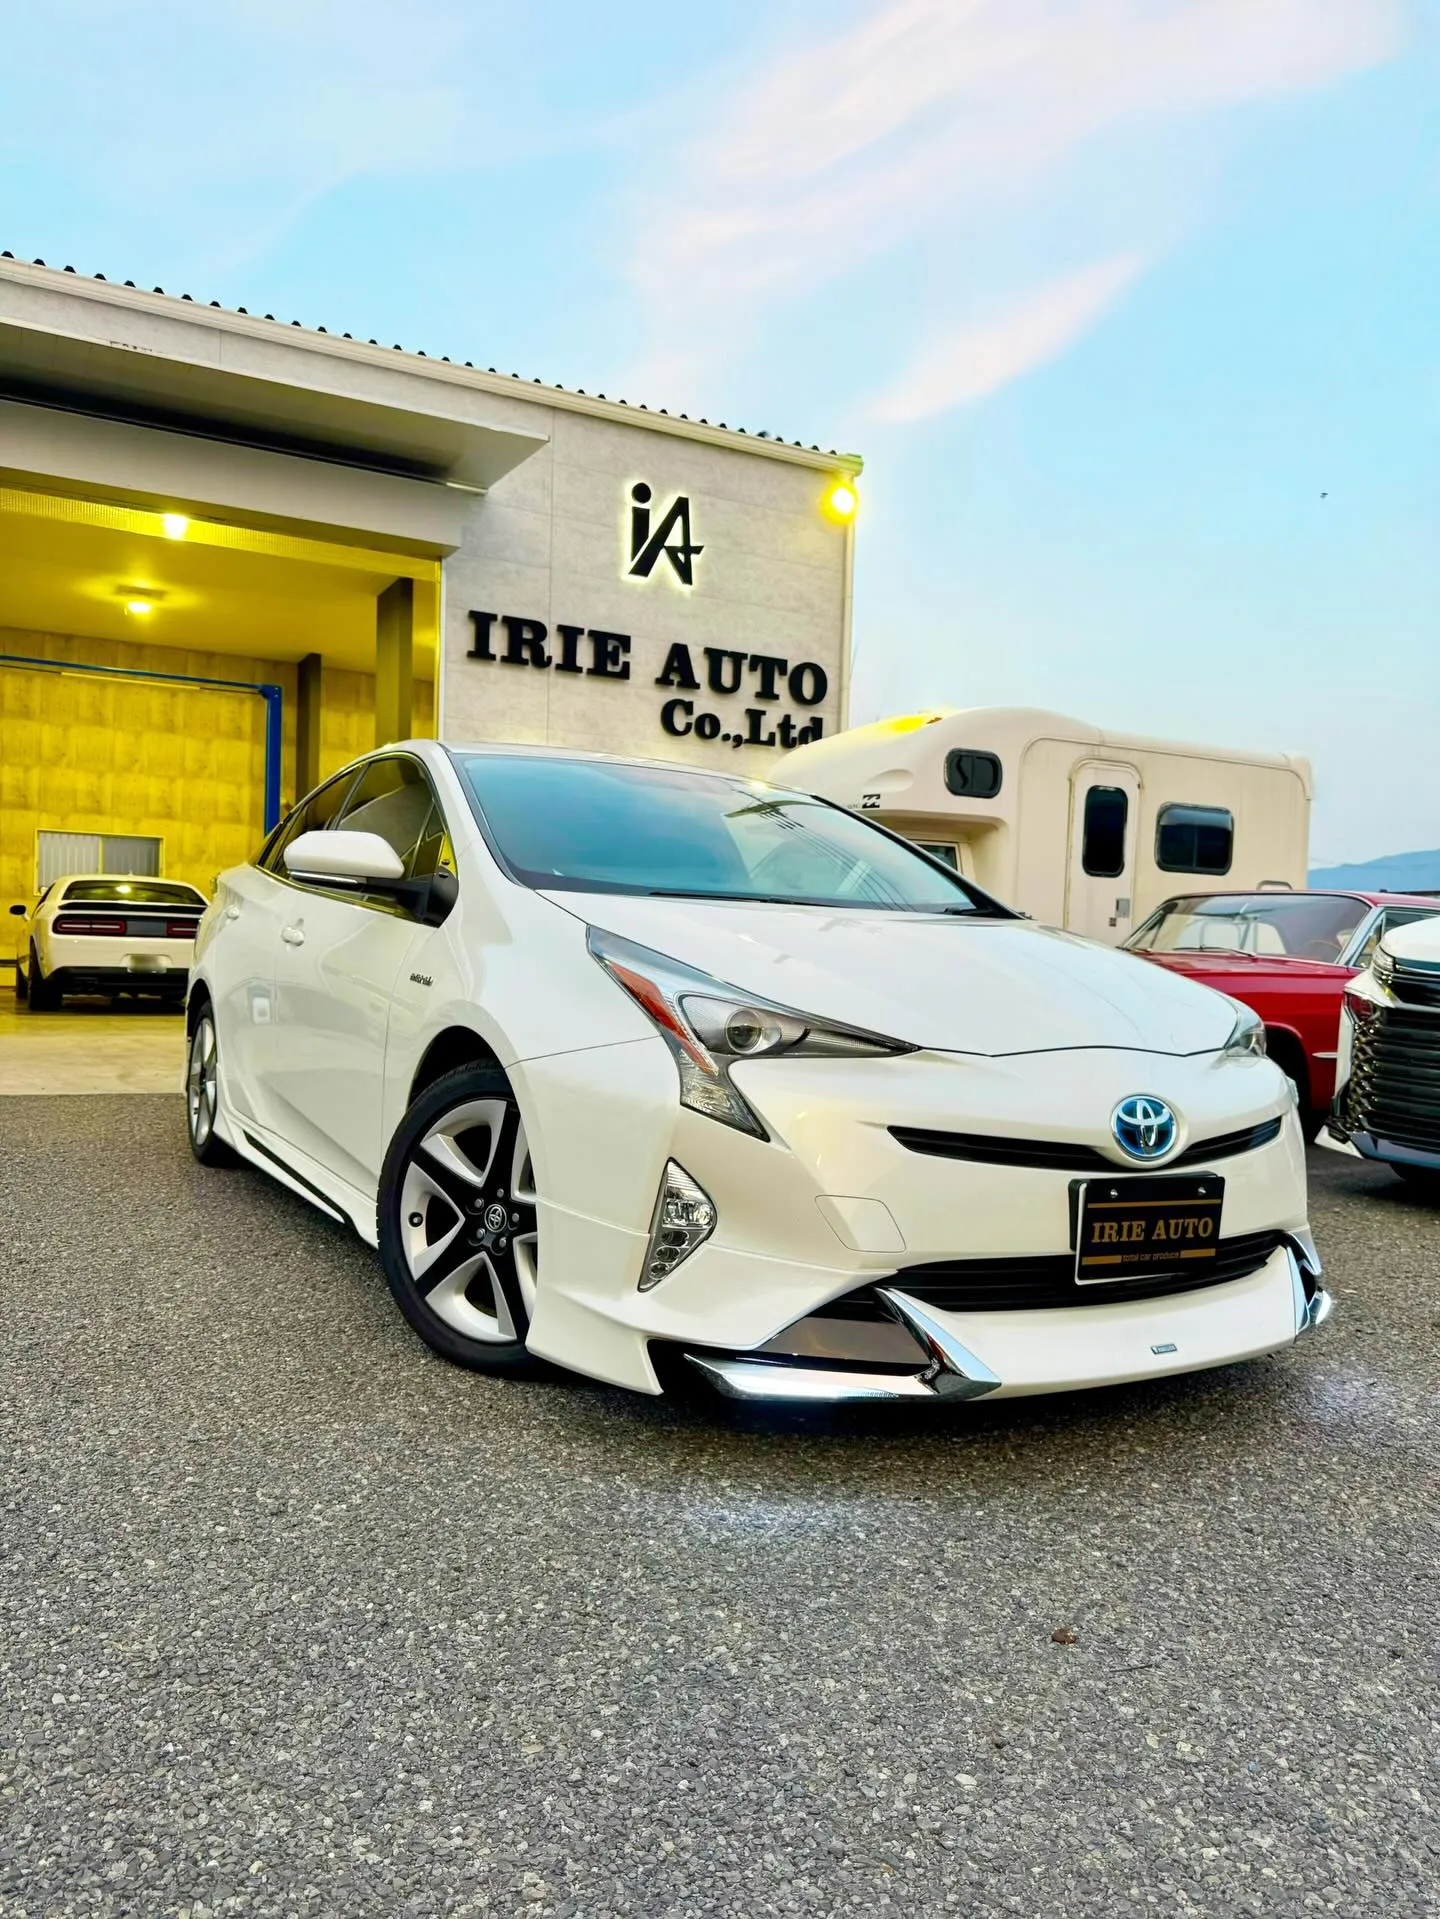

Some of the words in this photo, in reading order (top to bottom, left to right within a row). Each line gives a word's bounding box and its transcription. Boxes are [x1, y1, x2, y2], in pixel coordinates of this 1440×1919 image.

[467, 610, 631, 681] IRIE
[655, 642, 828, 705] AUTO
[660, 699, 824, 749] Co.,Ltd
[1091, 1221, 1146, 1243] IRIE
[1152, 1217, 1213, 1240] AUTO
